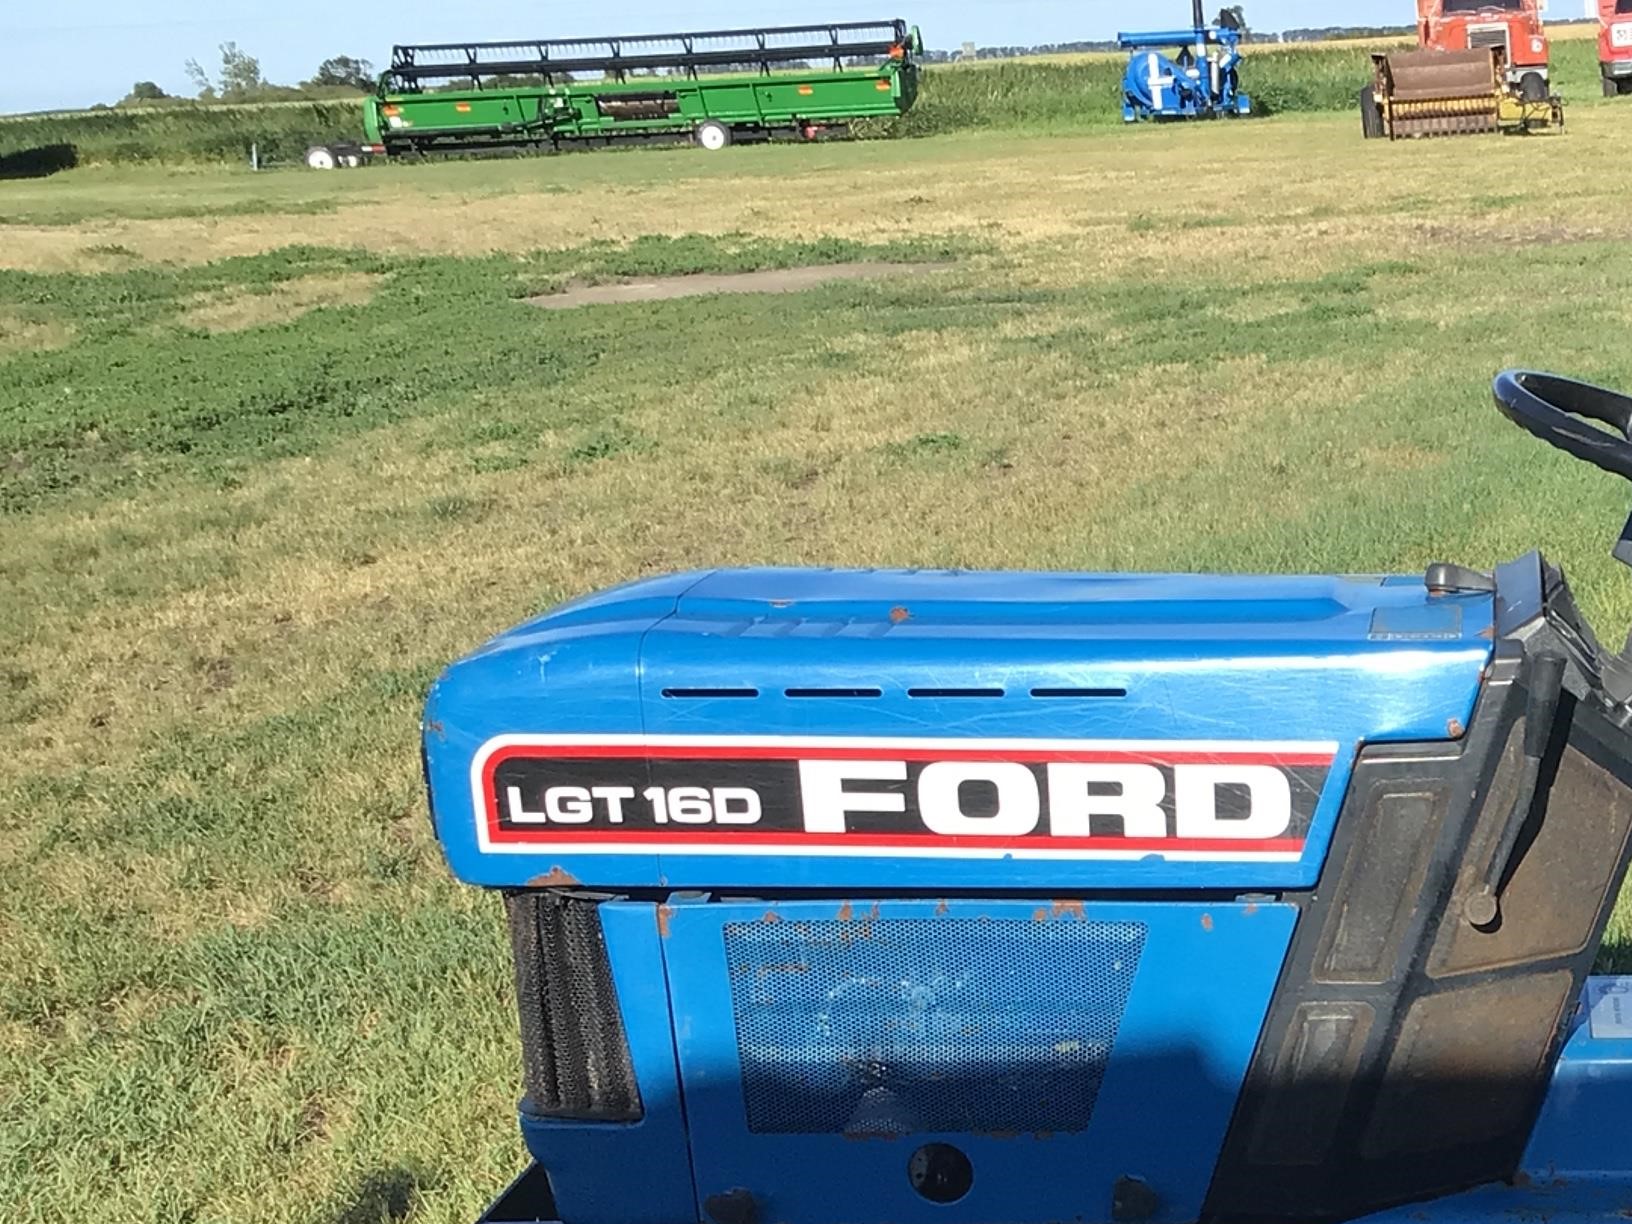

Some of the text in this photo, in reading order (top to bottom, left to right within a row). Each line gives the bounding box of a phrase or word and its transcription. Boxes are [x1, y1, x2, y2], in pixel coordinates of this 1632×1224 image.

[507, 787, 761, 823] LGT 16D
[799, 760, 1291, 838] FORD
